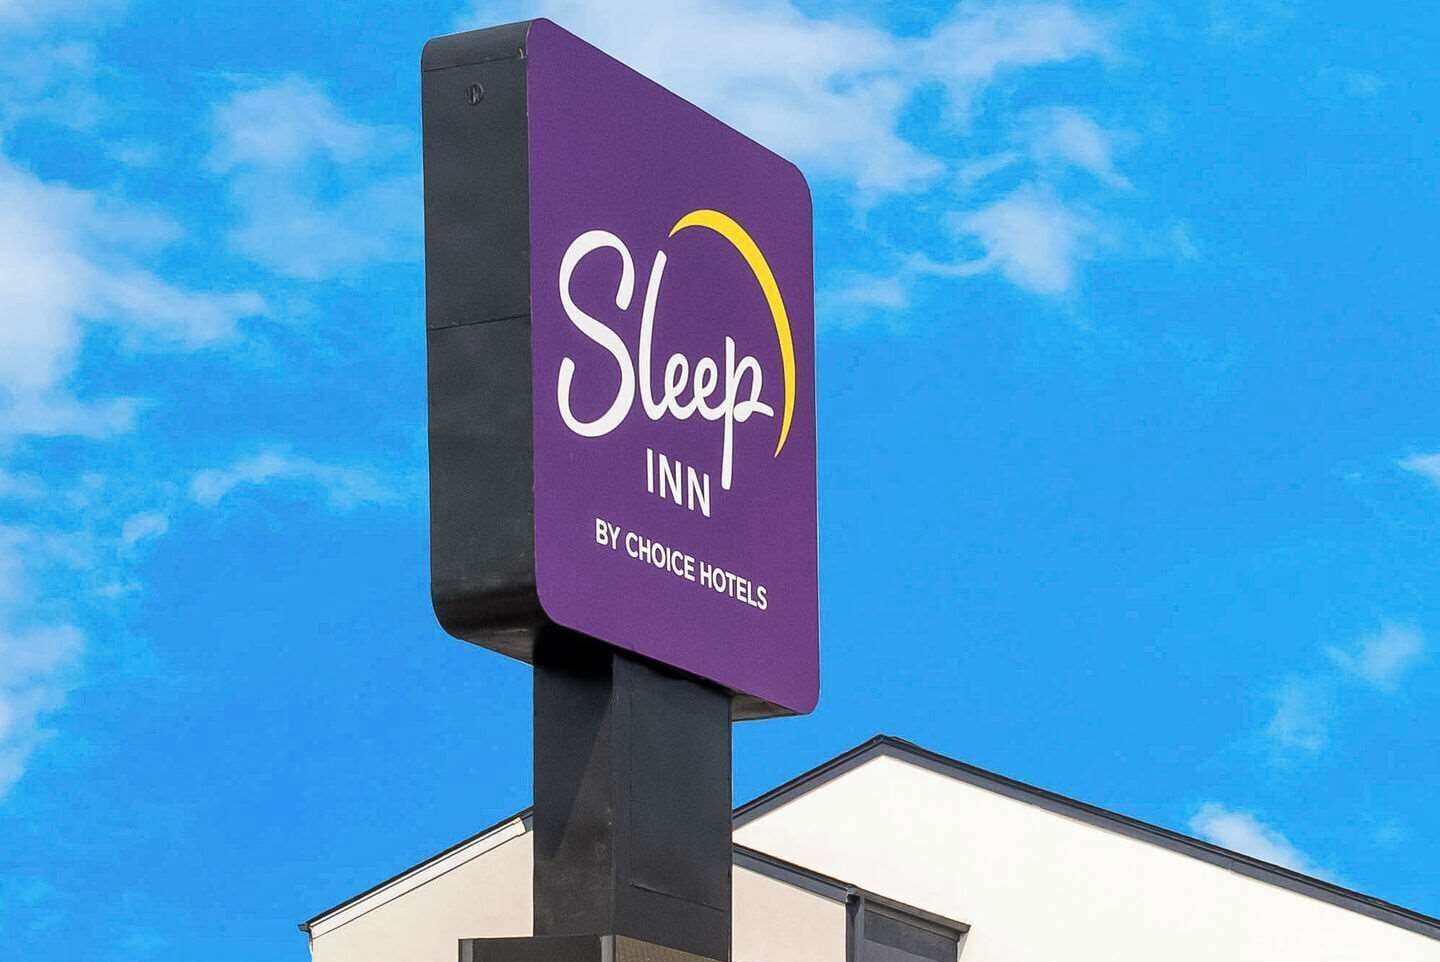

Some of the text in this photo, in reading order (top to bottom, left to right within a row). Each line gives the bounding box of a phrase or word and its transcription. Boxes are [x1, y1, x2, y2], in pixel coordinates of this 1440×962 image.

[557, 229, 775, 490] Sleep
[646, 447, 711, 518] INN
[595, 517, 768, 610] BY CHOICE HOTELS
